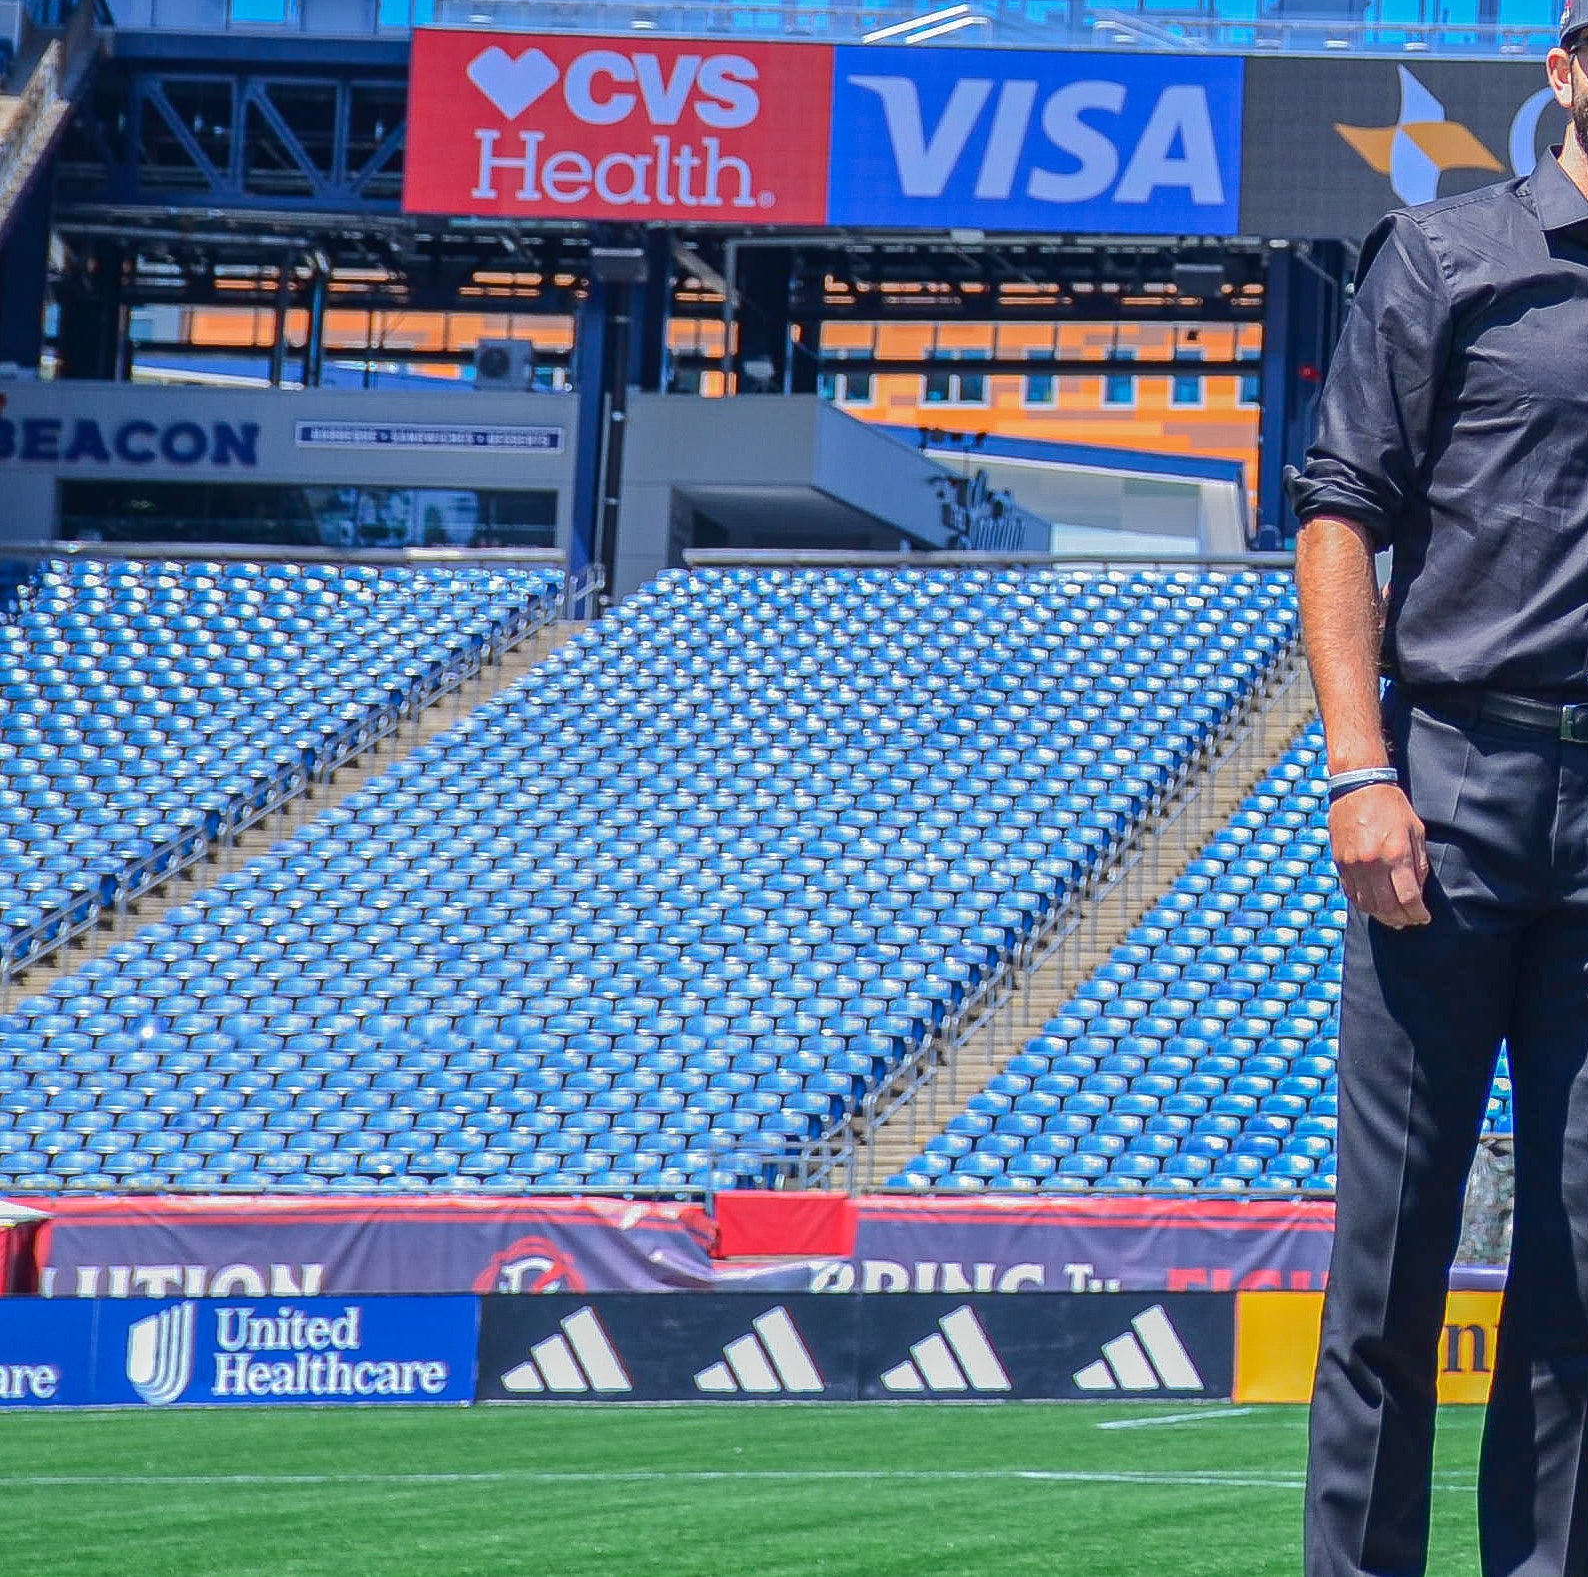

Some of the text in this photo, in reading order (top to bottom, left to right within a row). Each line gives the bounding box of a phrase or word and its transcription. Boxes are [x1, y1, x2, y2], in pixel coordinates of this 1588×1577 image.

[563, 48, 761, 130] CVS
[847, 74, 1225, 207] VISA
[214, 1305, 362, 1352] United
[211, 1351, 447, 1397] Healthcare
